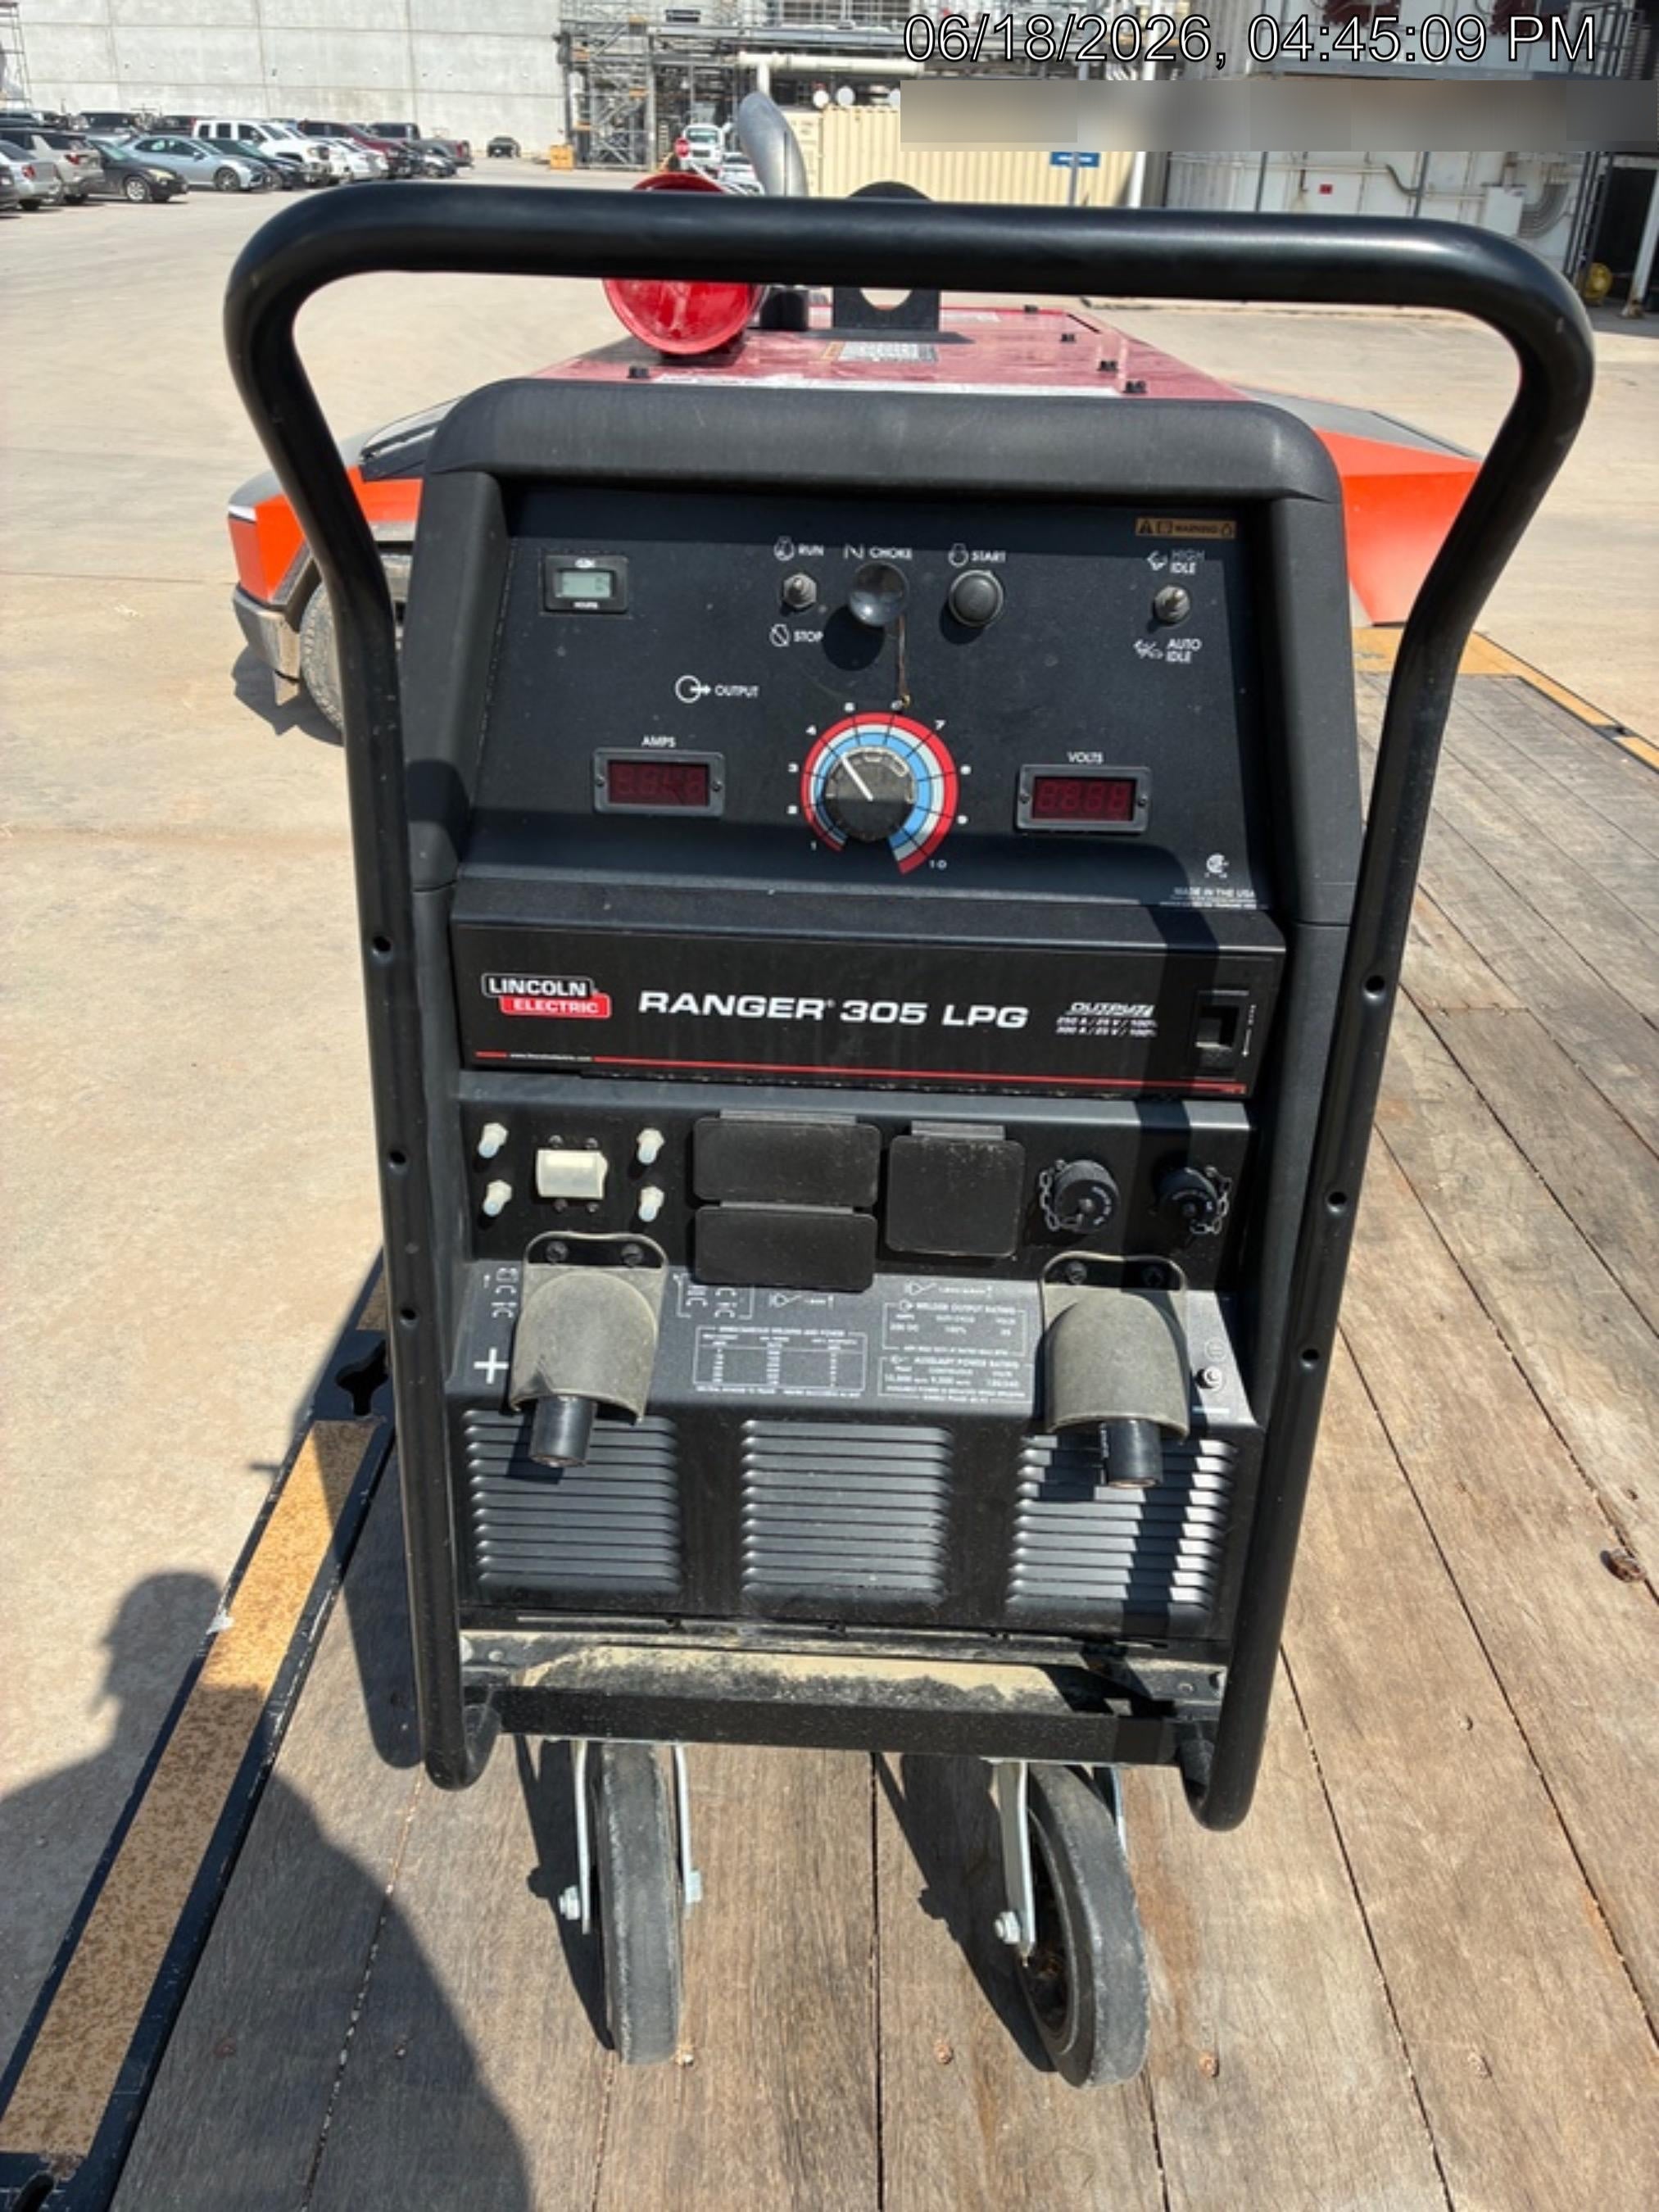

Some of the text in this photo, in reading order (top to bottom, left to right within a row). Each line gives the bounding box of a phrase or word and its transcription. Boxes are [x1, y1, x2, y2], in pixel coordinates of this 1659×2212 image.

[798, 544, 824, 556] RUN
[869, 547, 913, 559] CHOKE
[1172, 550, 1205, 562] HIGH
[971, 550, 1006, 564] START
[1170, 562, 1196, 573] IDLE
[793, 630, 823, 642] STOP
[1167, 638, 1203, 651] AUTO
[1165, 650, 1192, 664] IDLE
[714, 685, 759, 697] OUTPUT
[936, 719, 946, 730] 7
[641, 735, 676, 748] AMPS
[1067, 751, 1104, 764] VOLTS
[929, 859, 947, 869] 10
[488, 977, 587, 997] LINCOLN
[513, 997, 599, 1013] ELECTRIC
[840, 999, 928, 1025] 305
[941, 1004, 1030, 1029] LPG
